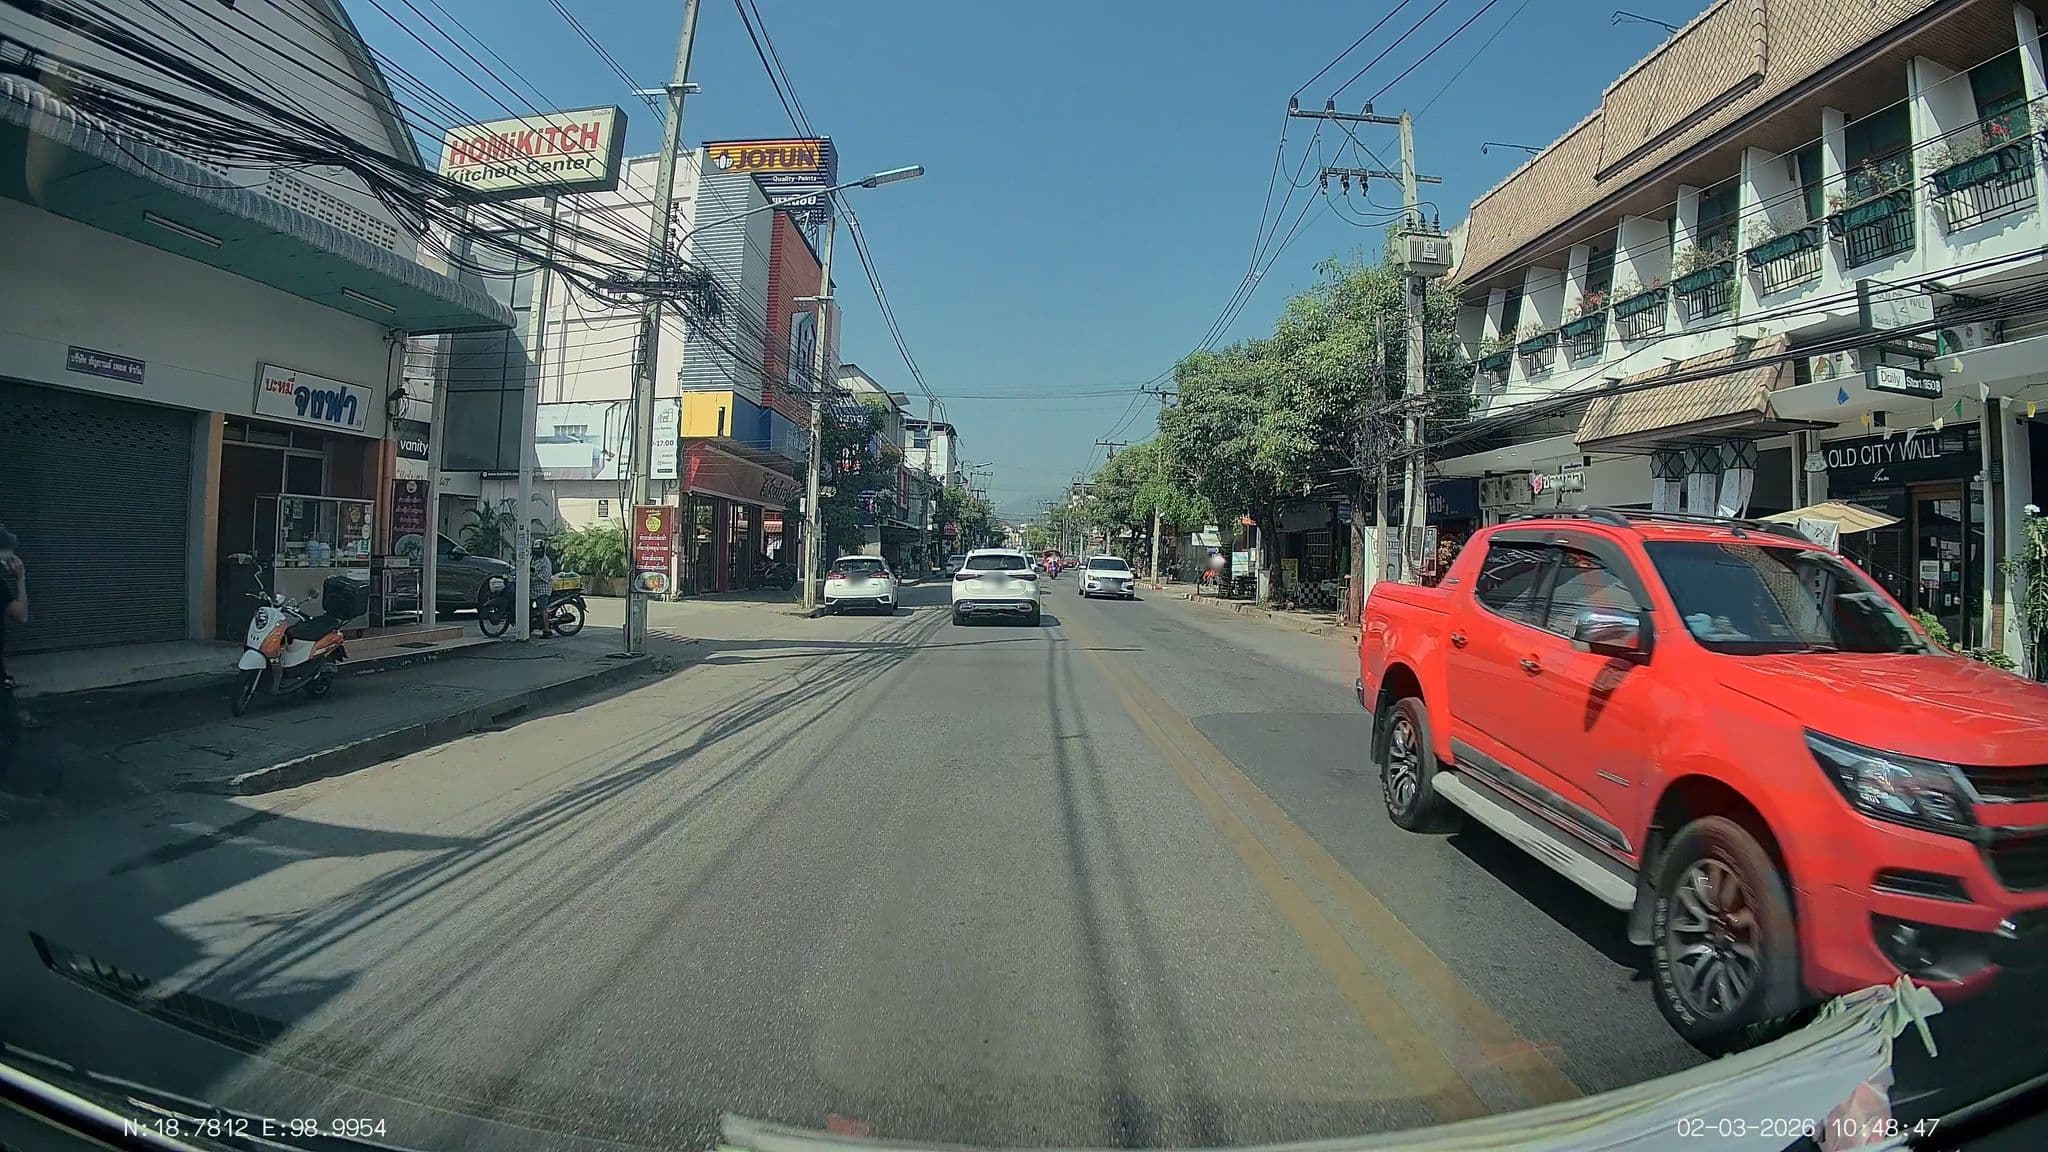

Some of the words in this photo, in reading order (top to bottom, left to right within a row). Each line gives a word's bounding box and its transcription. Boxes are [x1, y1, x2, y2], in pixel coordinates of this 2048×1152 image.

[736, 147, 815, 169] JOTUN
[446, 162, 518, 185] Kitchen
[526, 156, 595, 175] Center
[772, 175, 795, 183] Quality
[1880, 370, 1901, 386] Daily
[399, 438, 428, 457] vanity
[1828, 448, 1857, 468] OLD
[1861, 442, 1895, 465] CITY
[1899, 438, 1941, 461] WALL
